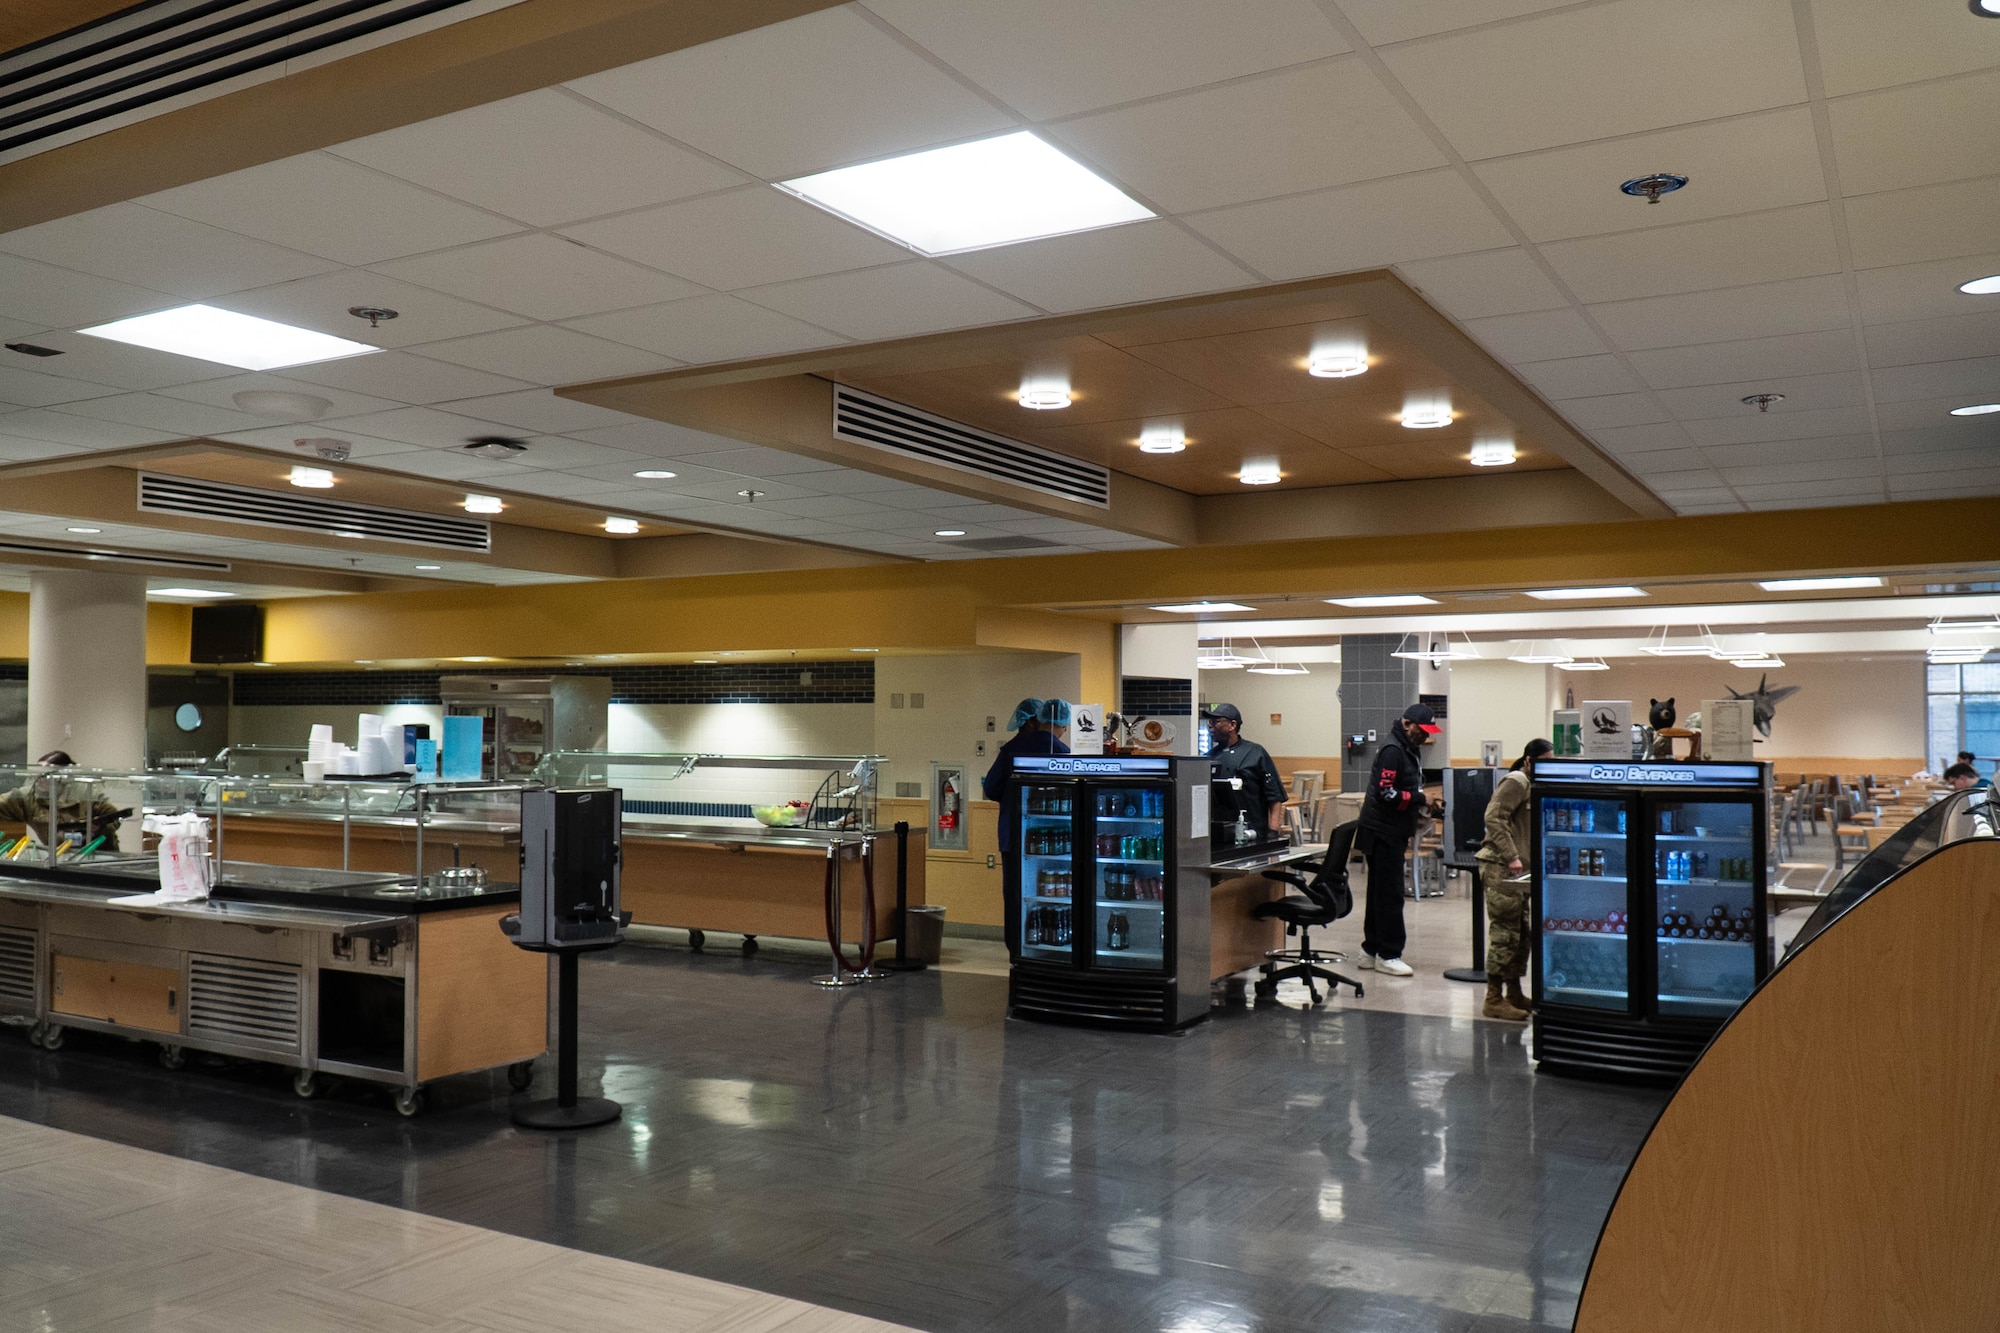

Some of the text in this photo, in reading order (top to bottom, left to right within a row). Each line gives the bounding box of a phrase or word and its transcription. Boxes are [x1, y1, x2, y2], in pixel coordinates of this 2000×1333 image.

[1048, 759, 1121, 772] COLD BEVERAGES
[1590, 766, 1695, 781] COLD BEVERAGES
